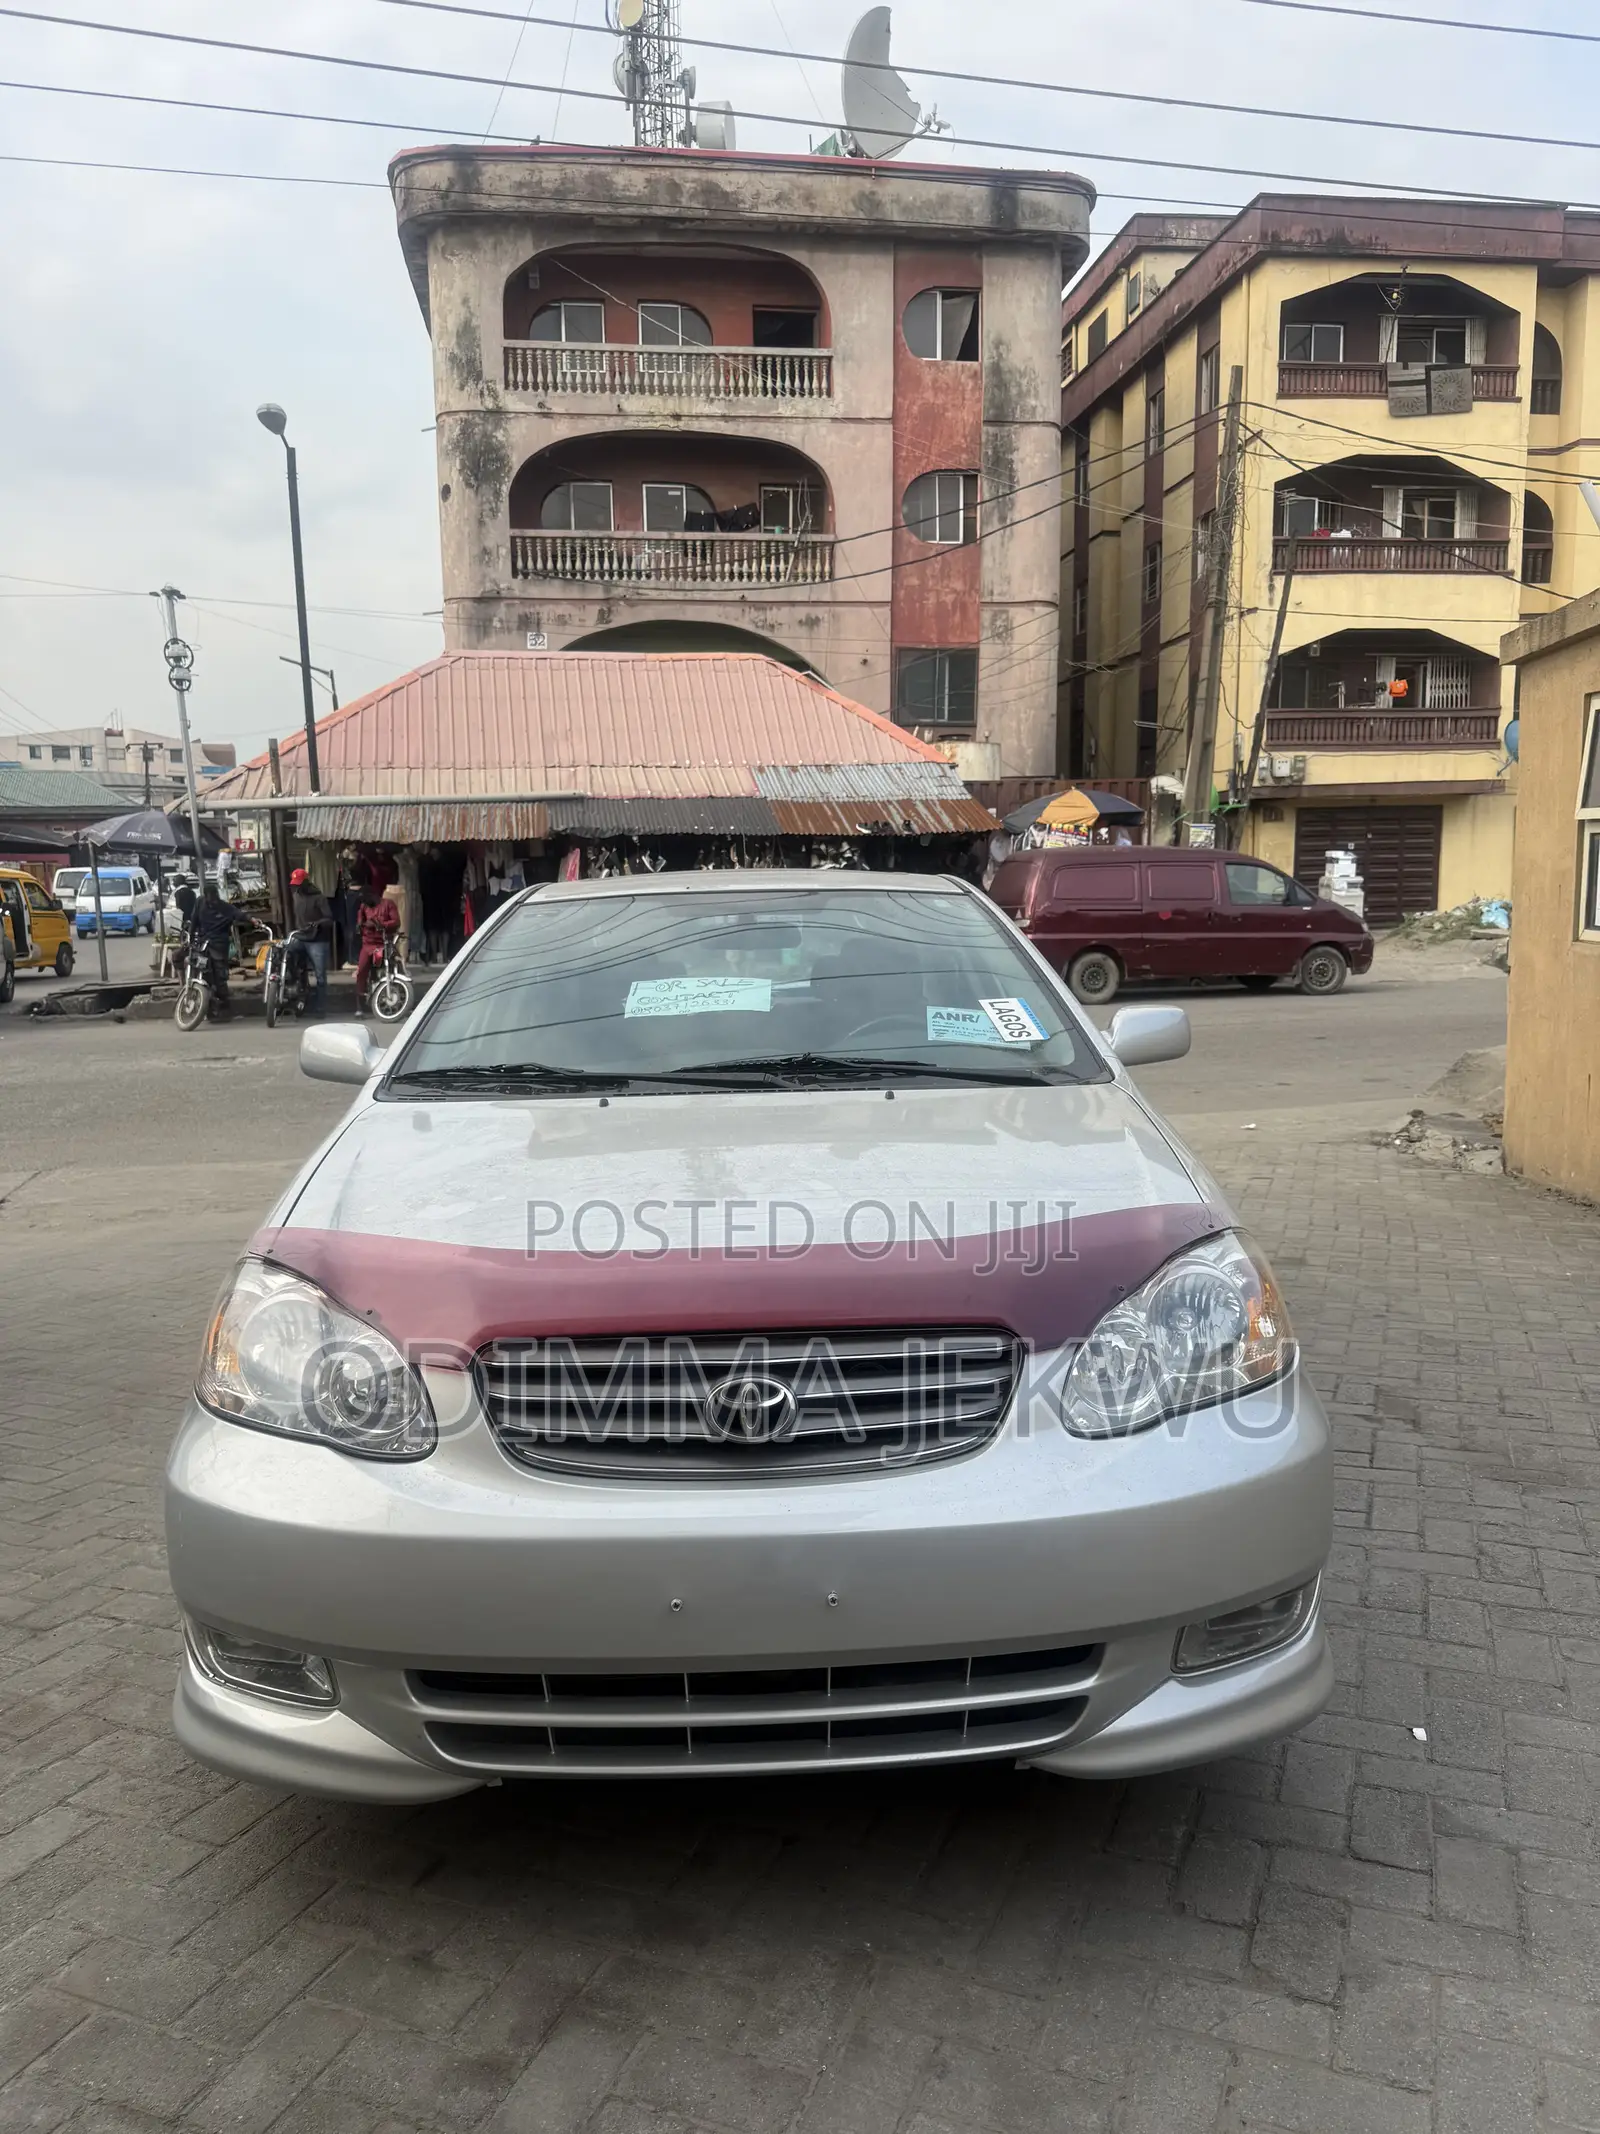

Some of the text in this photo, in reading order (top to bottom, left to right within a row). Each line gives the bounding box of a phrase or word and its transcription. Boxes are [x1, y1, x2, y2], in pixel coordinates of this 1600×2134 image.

[631, 978, 755, 997] FOR SALE
[637, 990, 740, 1005] CONTACT
[988, 1000, 1032, 1039] LAGOS
